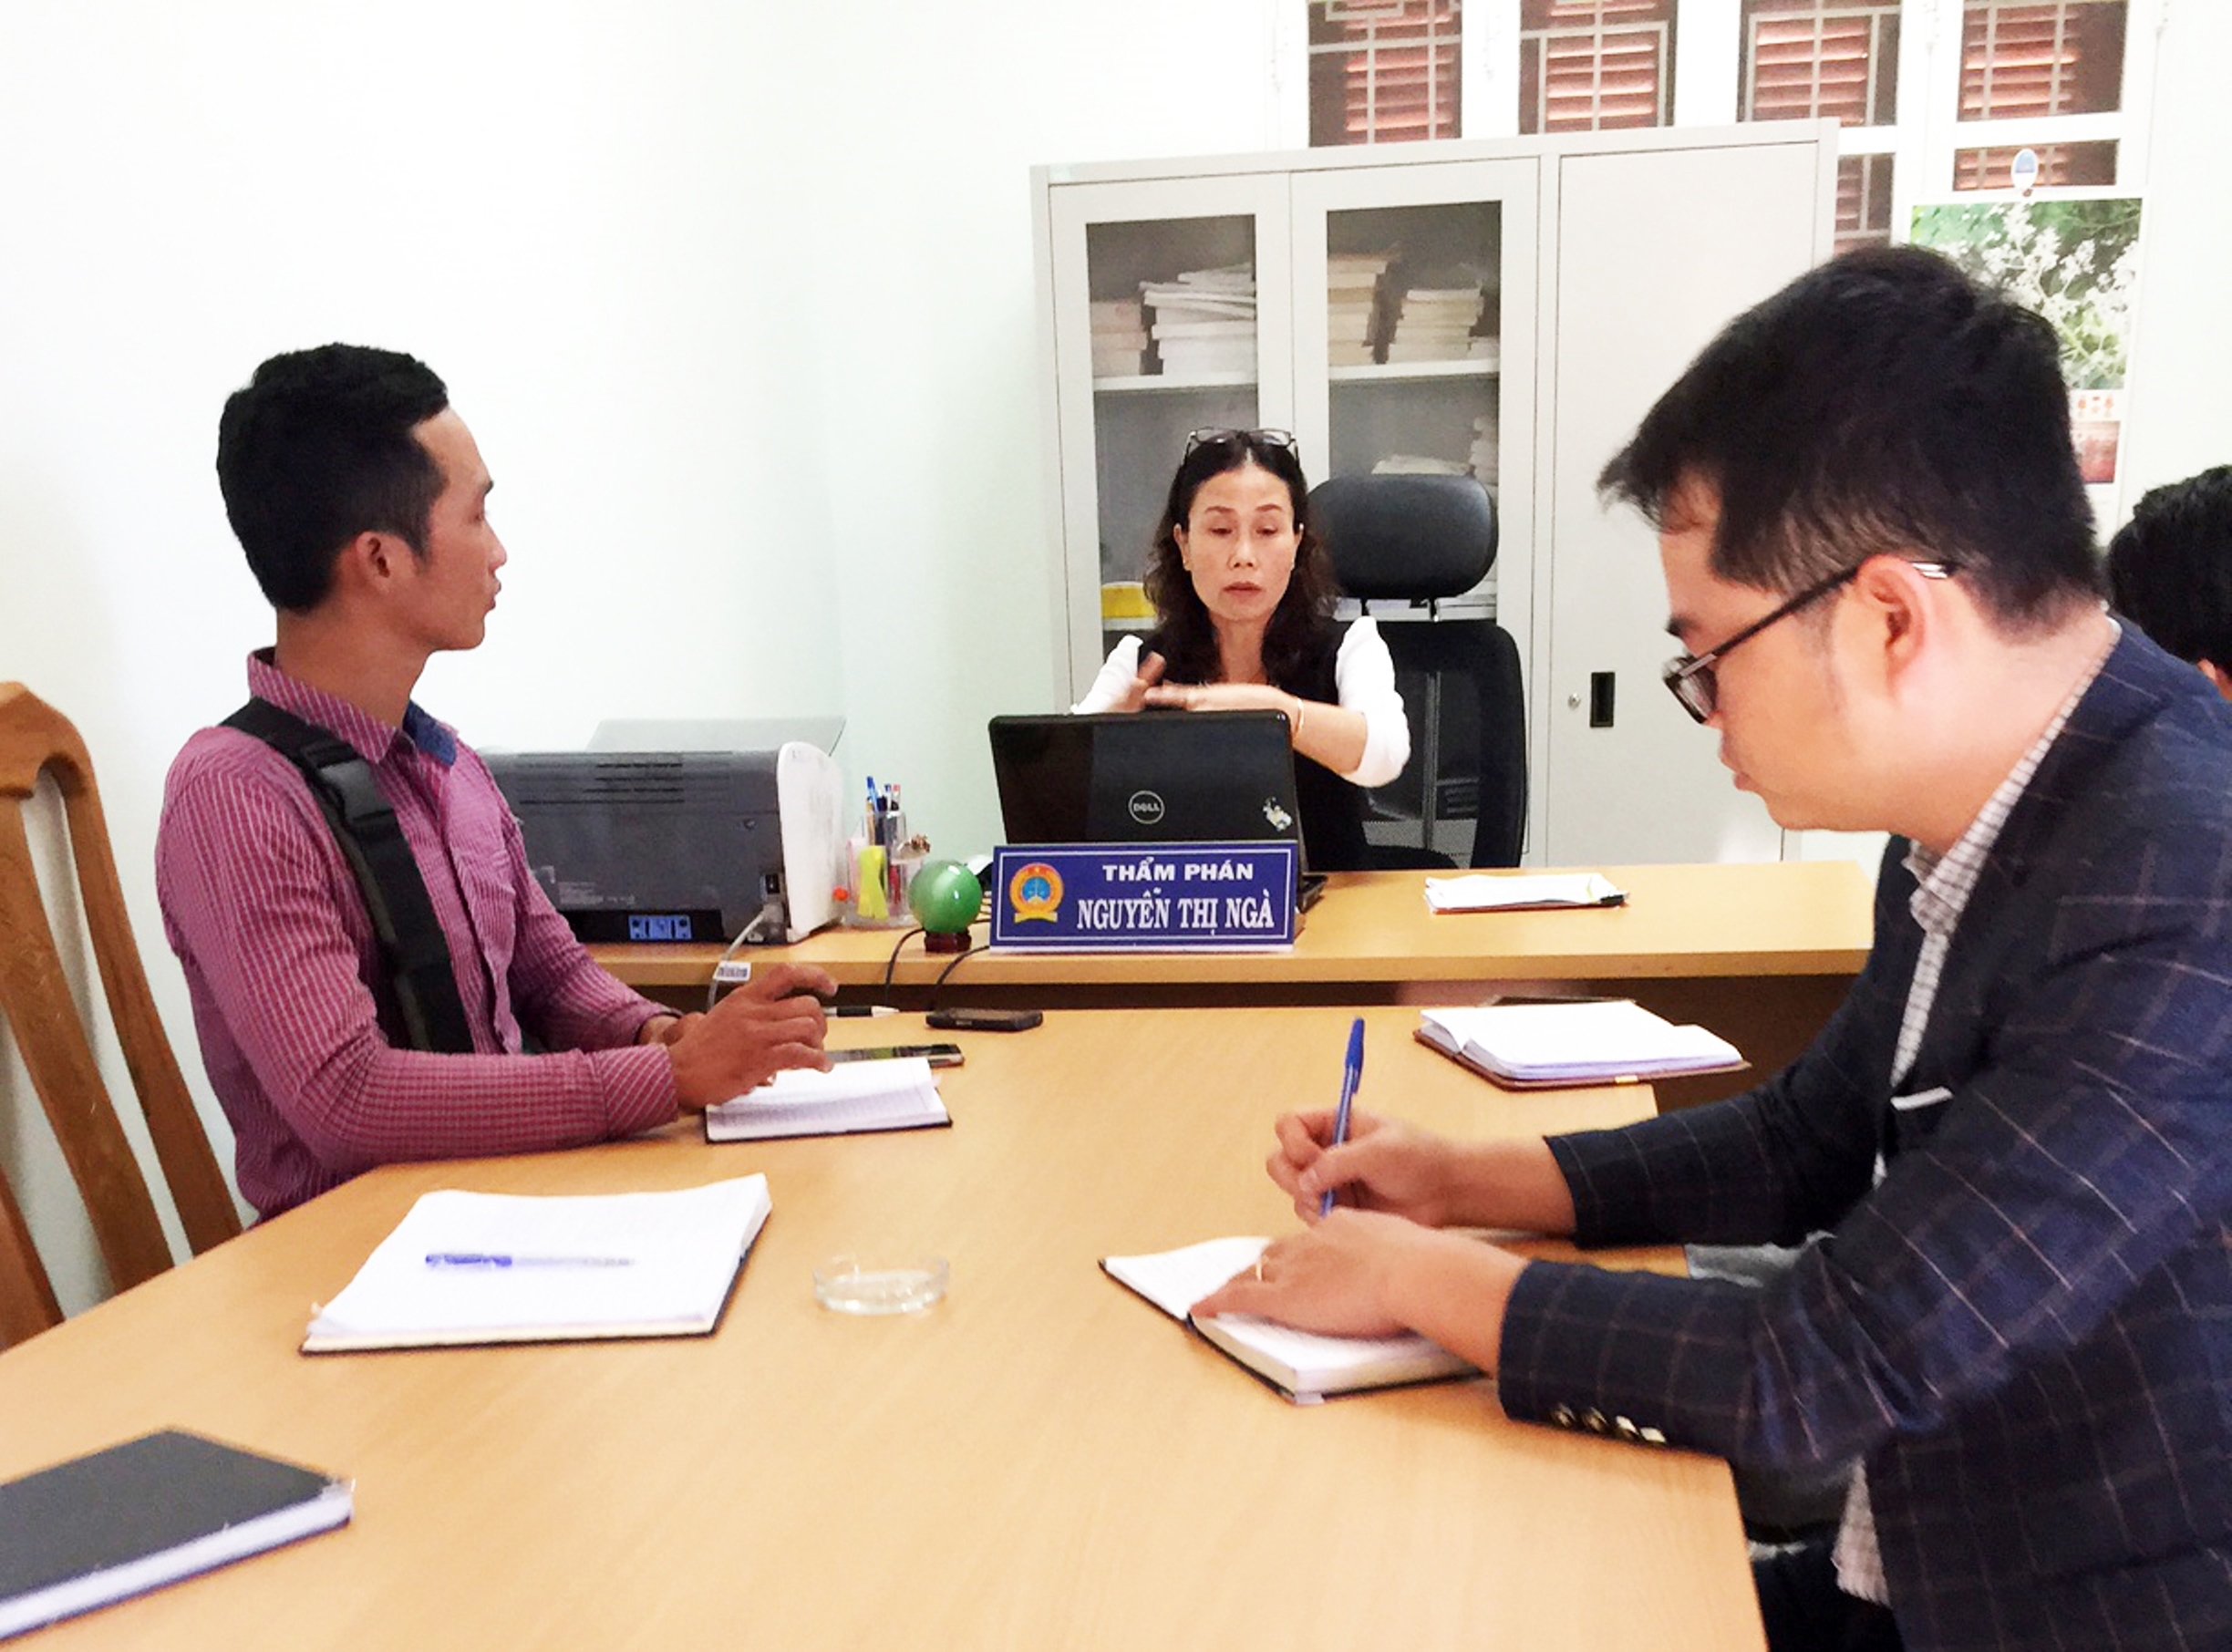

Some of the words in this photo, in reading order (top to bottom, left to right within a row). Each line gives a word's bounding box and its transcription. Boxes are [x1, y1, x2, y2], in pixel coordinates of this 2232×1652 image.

[1133, 803, 1160, 812] DELL
[1102, 857, 1175, 882] THẨM
[1184, 860, 1254, 881] PHÁN
[1077, 887, 1172, 929] NGUYỄN
[1177, 898, 1219, 936] THỊ
[1226, 888, 1275, 929] NGÀ
